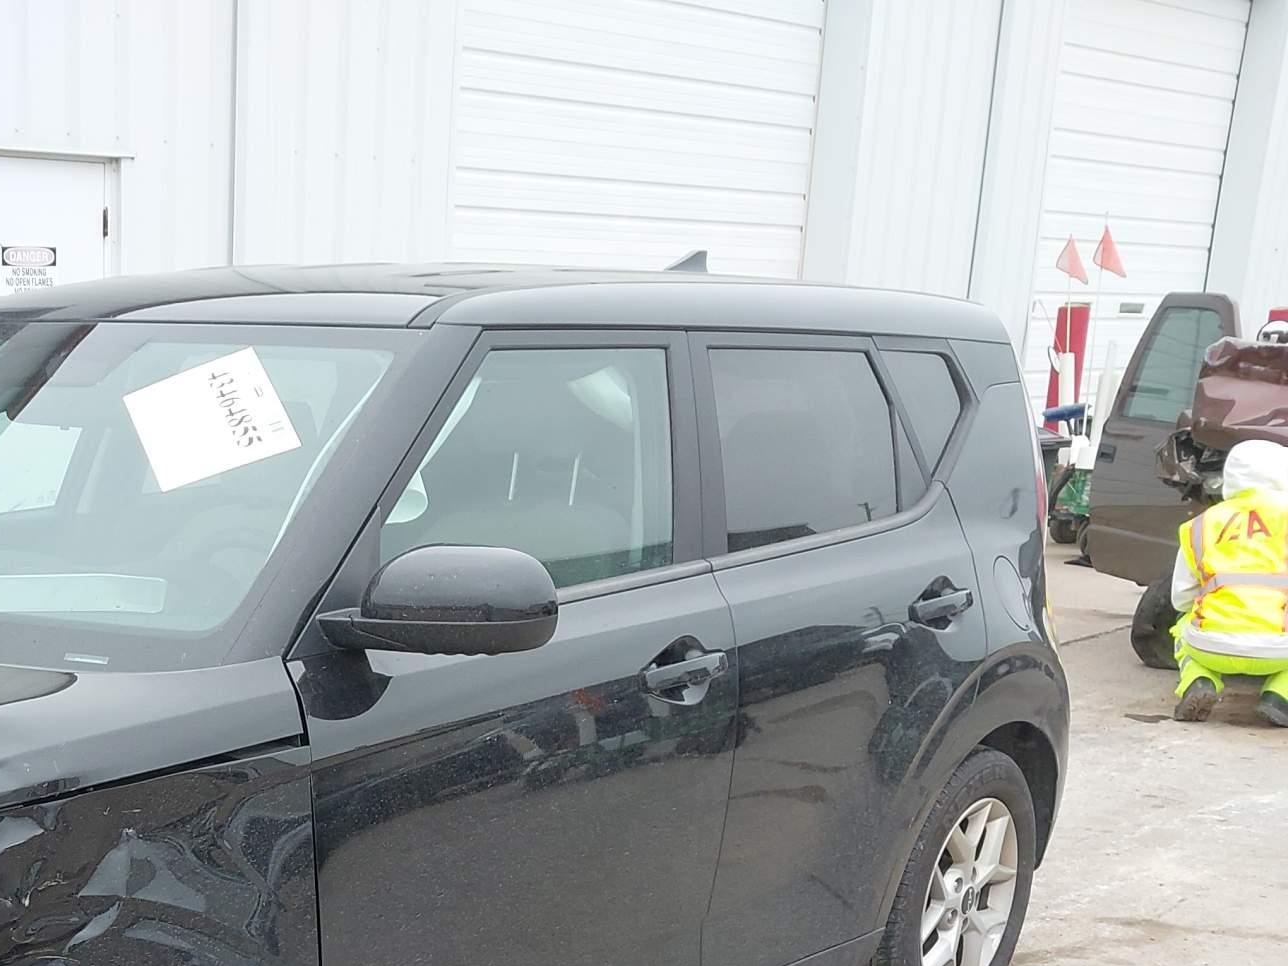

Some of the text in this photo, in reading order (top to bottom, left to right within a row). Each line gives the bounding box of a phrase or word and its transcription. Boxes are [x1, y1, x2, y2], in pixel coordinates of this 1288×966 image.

[9, 250, 50, 262] DANGER
[12, 267, 47, 277] NO SMOKING
[6, 277, 54, 287] NO OPEN FLAMES
[207, 371, 264, 448] 43464855
